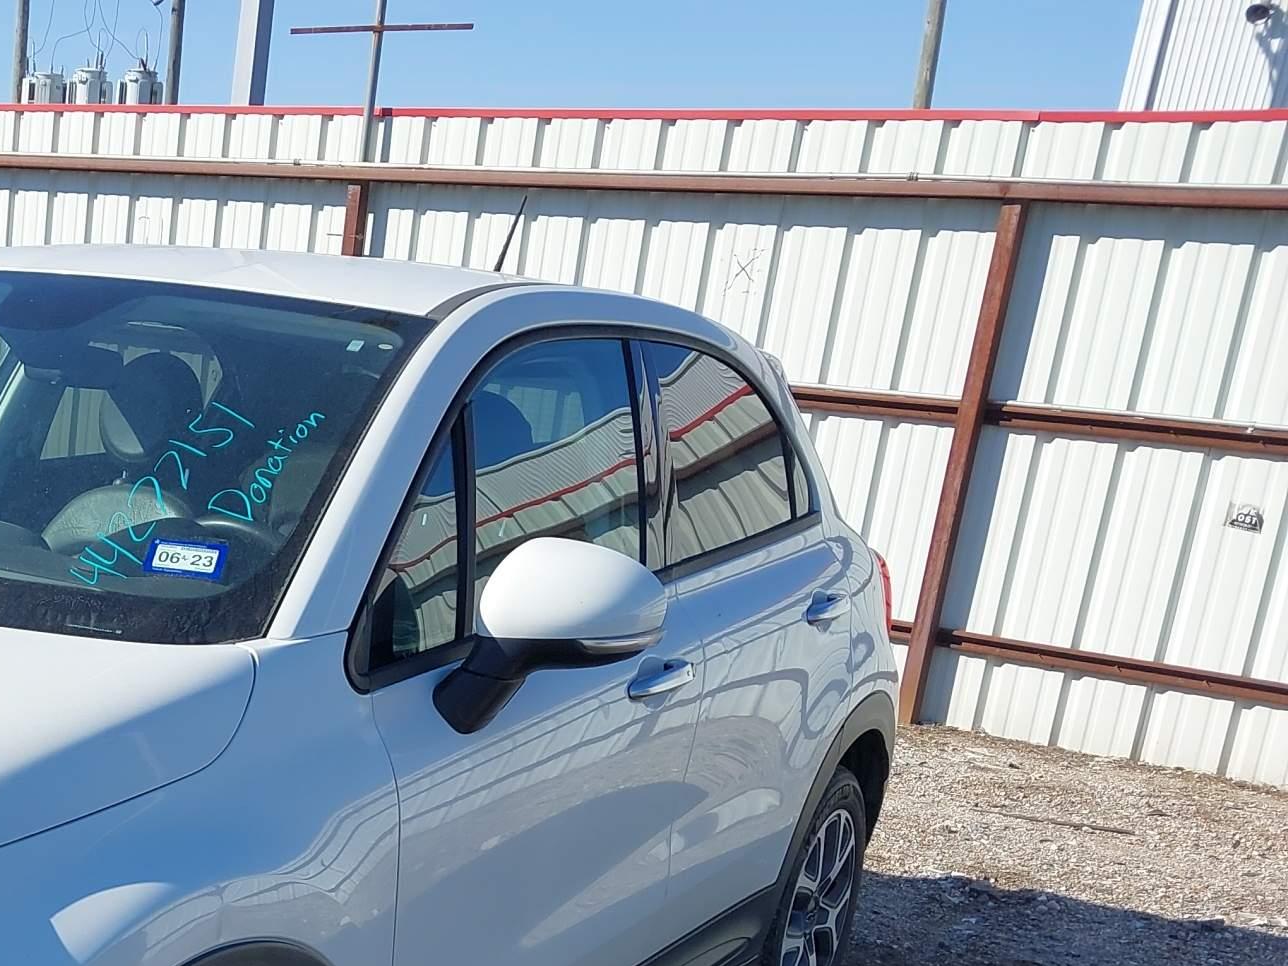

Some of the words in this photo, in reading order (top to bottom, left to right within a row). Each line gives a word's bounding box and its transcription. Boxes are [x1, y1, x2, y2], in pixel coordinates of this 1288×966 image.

[208, 410, 327, 522] Donation
[158, 551, 181, 564] 06
[189, 554, 214, 567] 23
